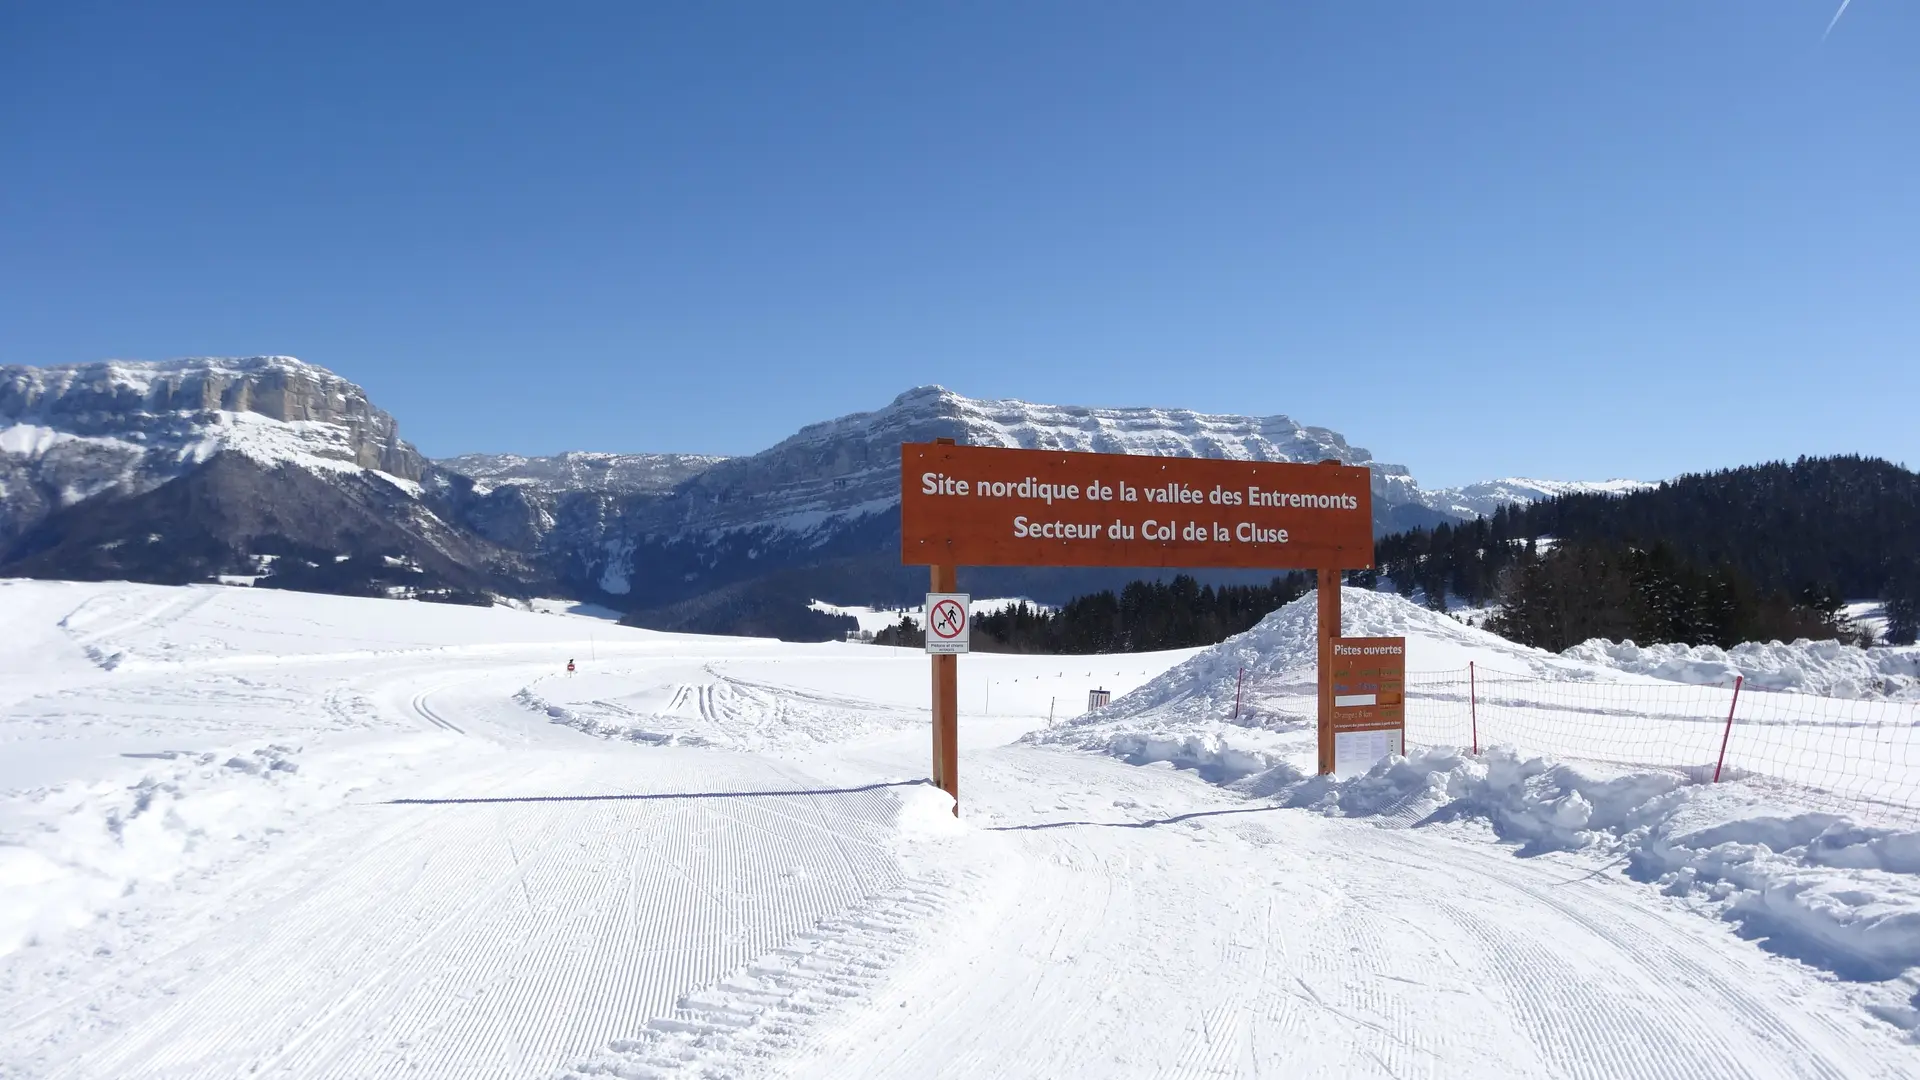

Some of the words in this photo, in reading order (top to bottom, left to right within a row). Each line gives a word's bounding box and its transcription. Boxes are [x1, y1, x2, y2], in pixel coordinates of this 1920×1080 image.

[921, 472, 970, 496] Site
[977, 476, 1080, 506] nordique
[1086, 479, 1113, 502] de
[1119, 480, 1138, 502] la
[1143, 482, 1203, 505] vallée
[1209, 483, 1242, 507] des
[1248, 486, 1358, 510] Entremonts
[1013, 515, 1102, 539] Secteur
[1107, 519, 1135, 540] du
[1141, 519, 1176, 541] Col
[1182, 521, 1208, 542] de
[1213, 521, 1231, 542] la
[1235, 522, 1289, 543] Cluse
[1334, 644, 1362, 656] Pistes
[1363, 645, 1402, 655] ouvertes
